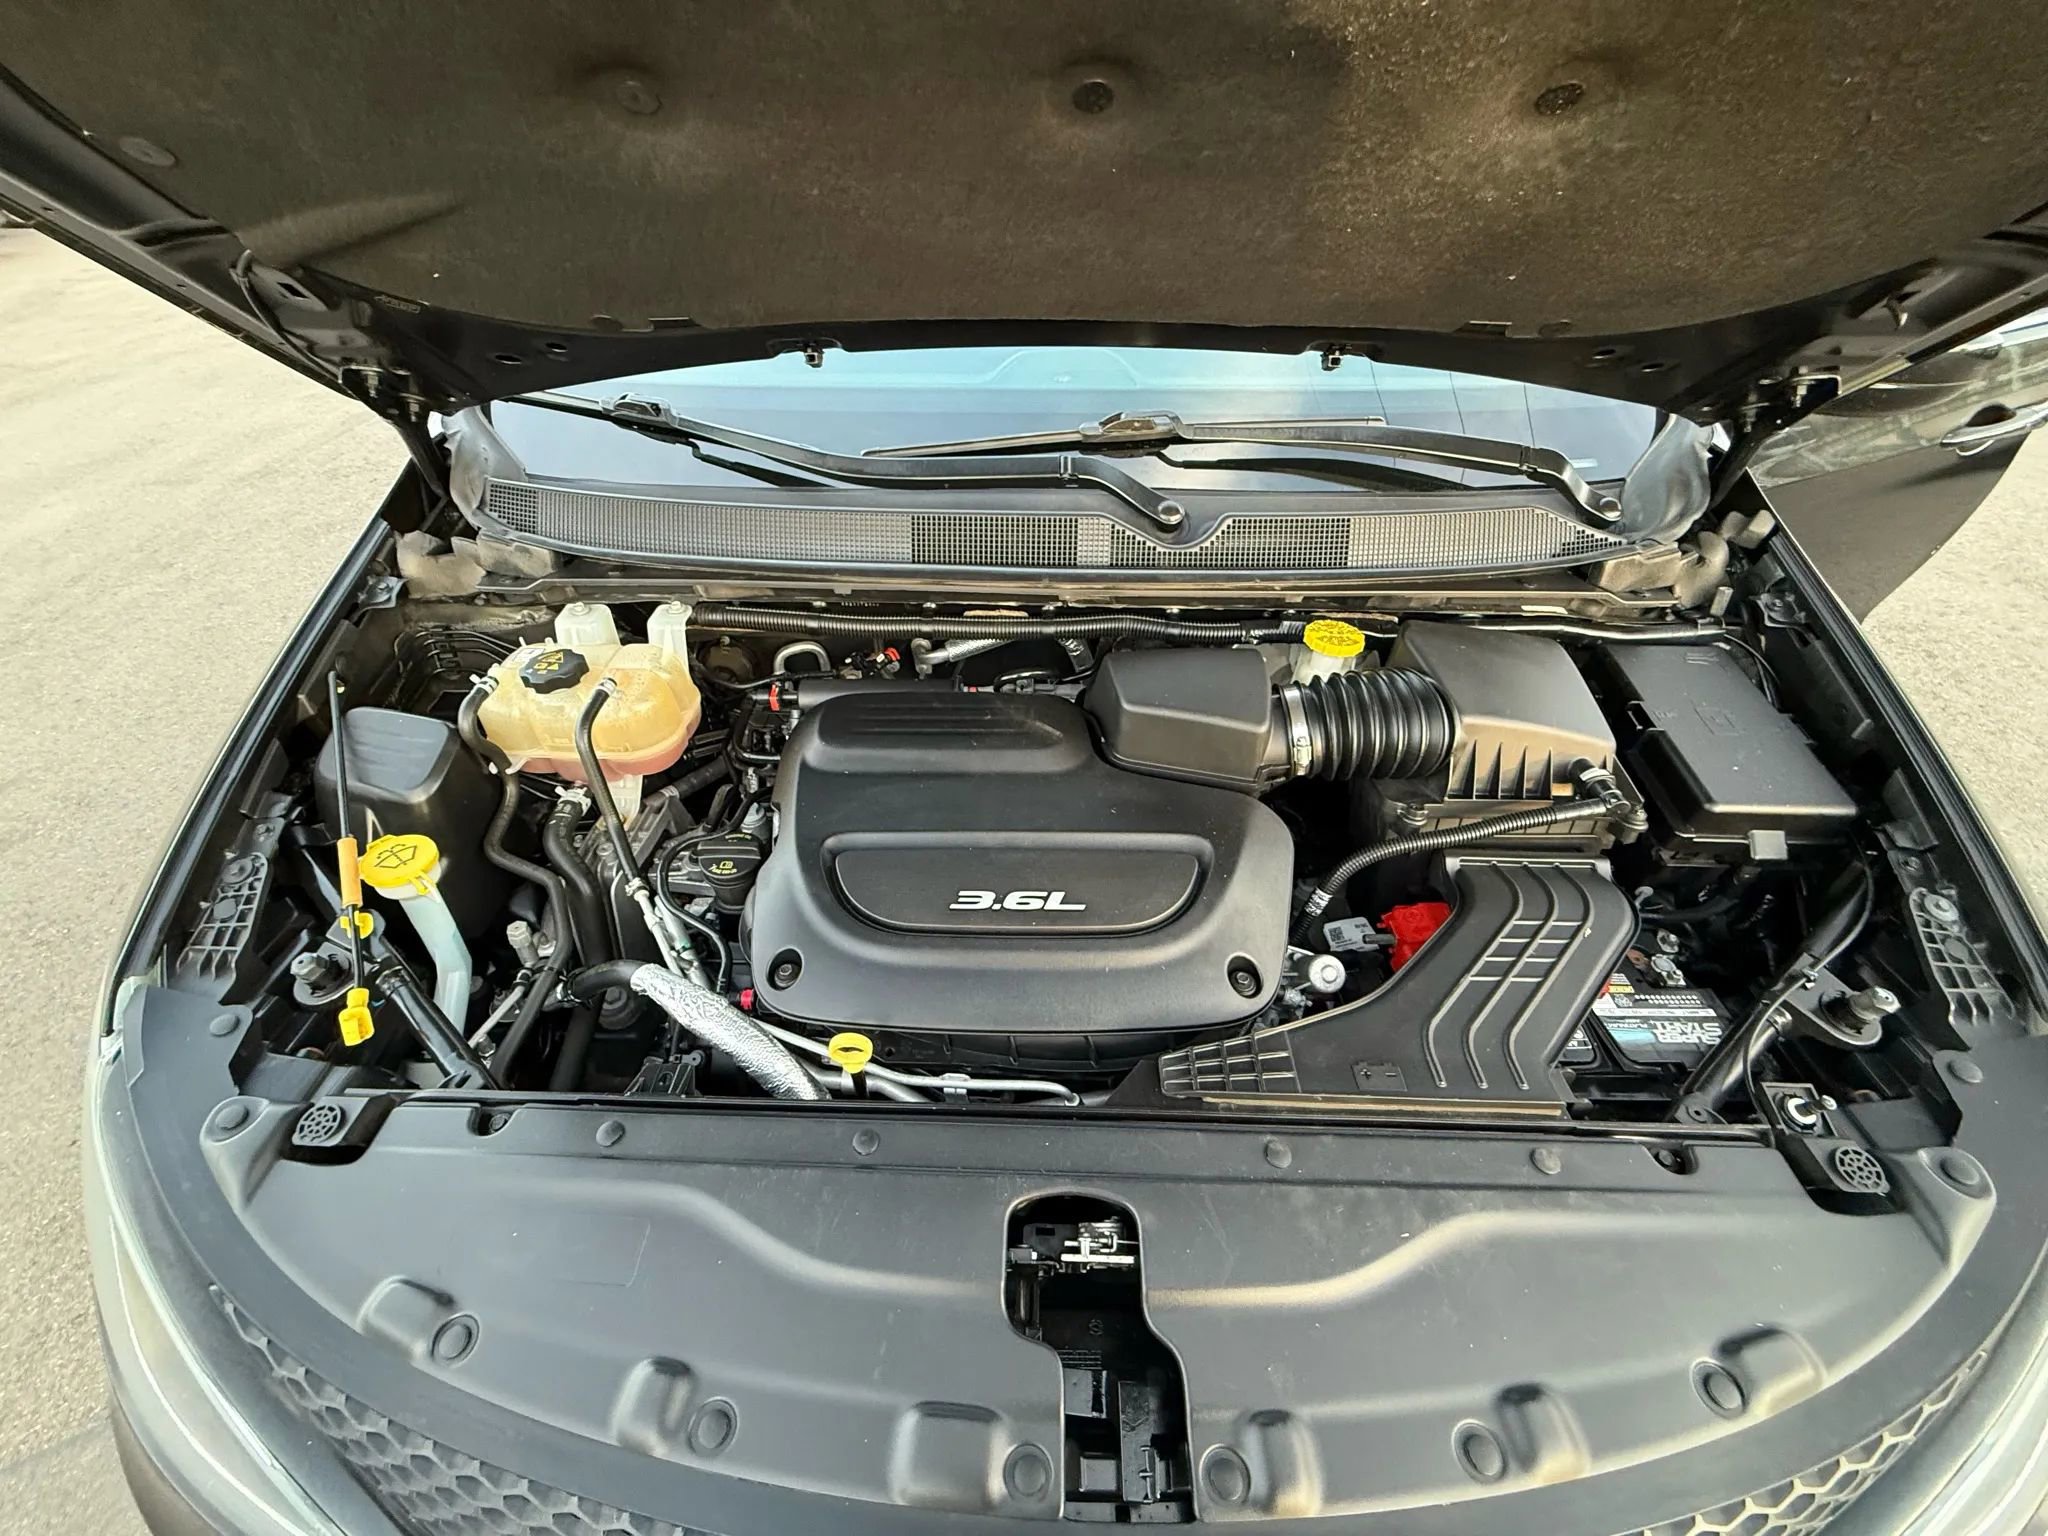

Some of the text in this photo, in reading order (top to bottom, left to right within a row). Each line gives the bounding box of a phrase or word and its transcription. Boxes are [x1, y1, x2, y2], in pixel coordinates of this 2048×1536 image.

[949, 890, 1087, 911] 3.6L
[1654, 1021, 1722, 1036] START
[1657, 1034, 1721, 1045] SUPER
